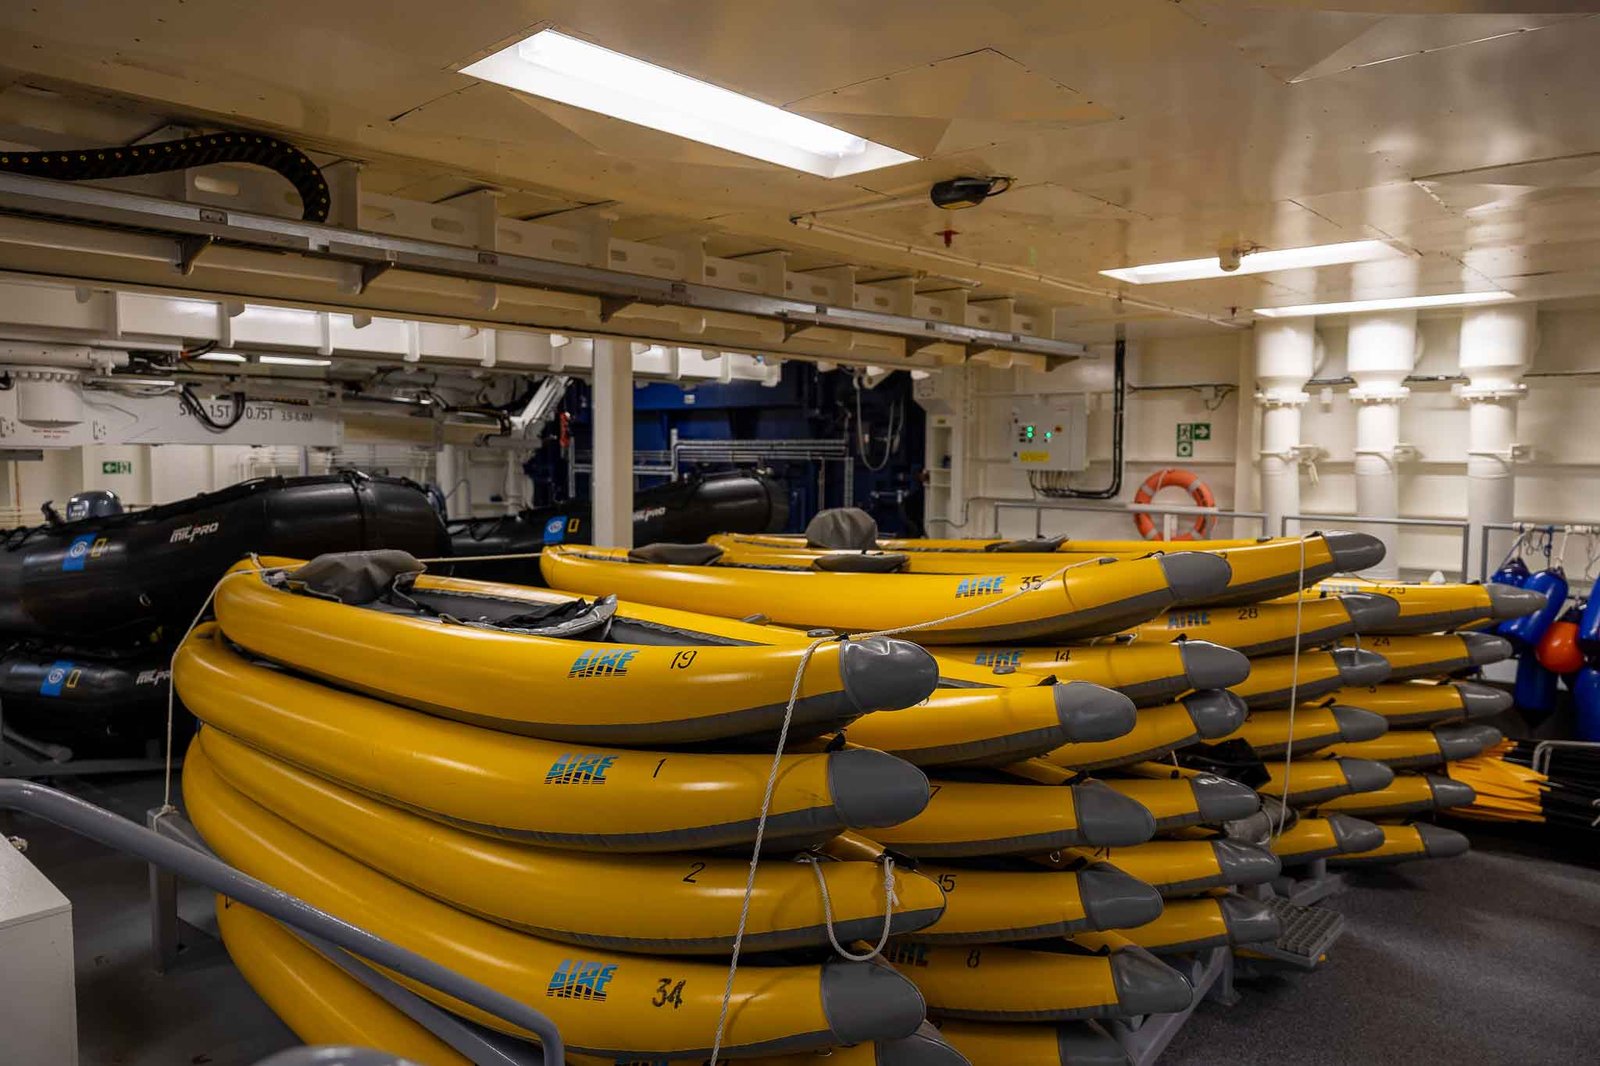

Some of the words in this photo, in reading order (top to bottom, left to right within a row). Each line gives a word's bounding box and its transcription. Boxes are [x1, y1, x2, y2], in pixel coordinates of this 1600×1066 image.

[210, 405, 231, 418] 1.5T
[246, 407, 274, 420] 0.75T
[955, 576, 1005, 598] AIRE
[1020, 575, 1043, 591] 35
[1238, 607, 1258, 620] 28
[567, 649, 640, 678] AIRE
[670, 650, 698, 669] 19
[1055, 649, 1071, 662] 14
[543, 753, 619, 784] AIRE
[652, 758, 667, 779] 1
[682, 862, 706, 883] 2
[546, 959, 619, 1002] AIRE
[651, 977, 686, 1009] 34
